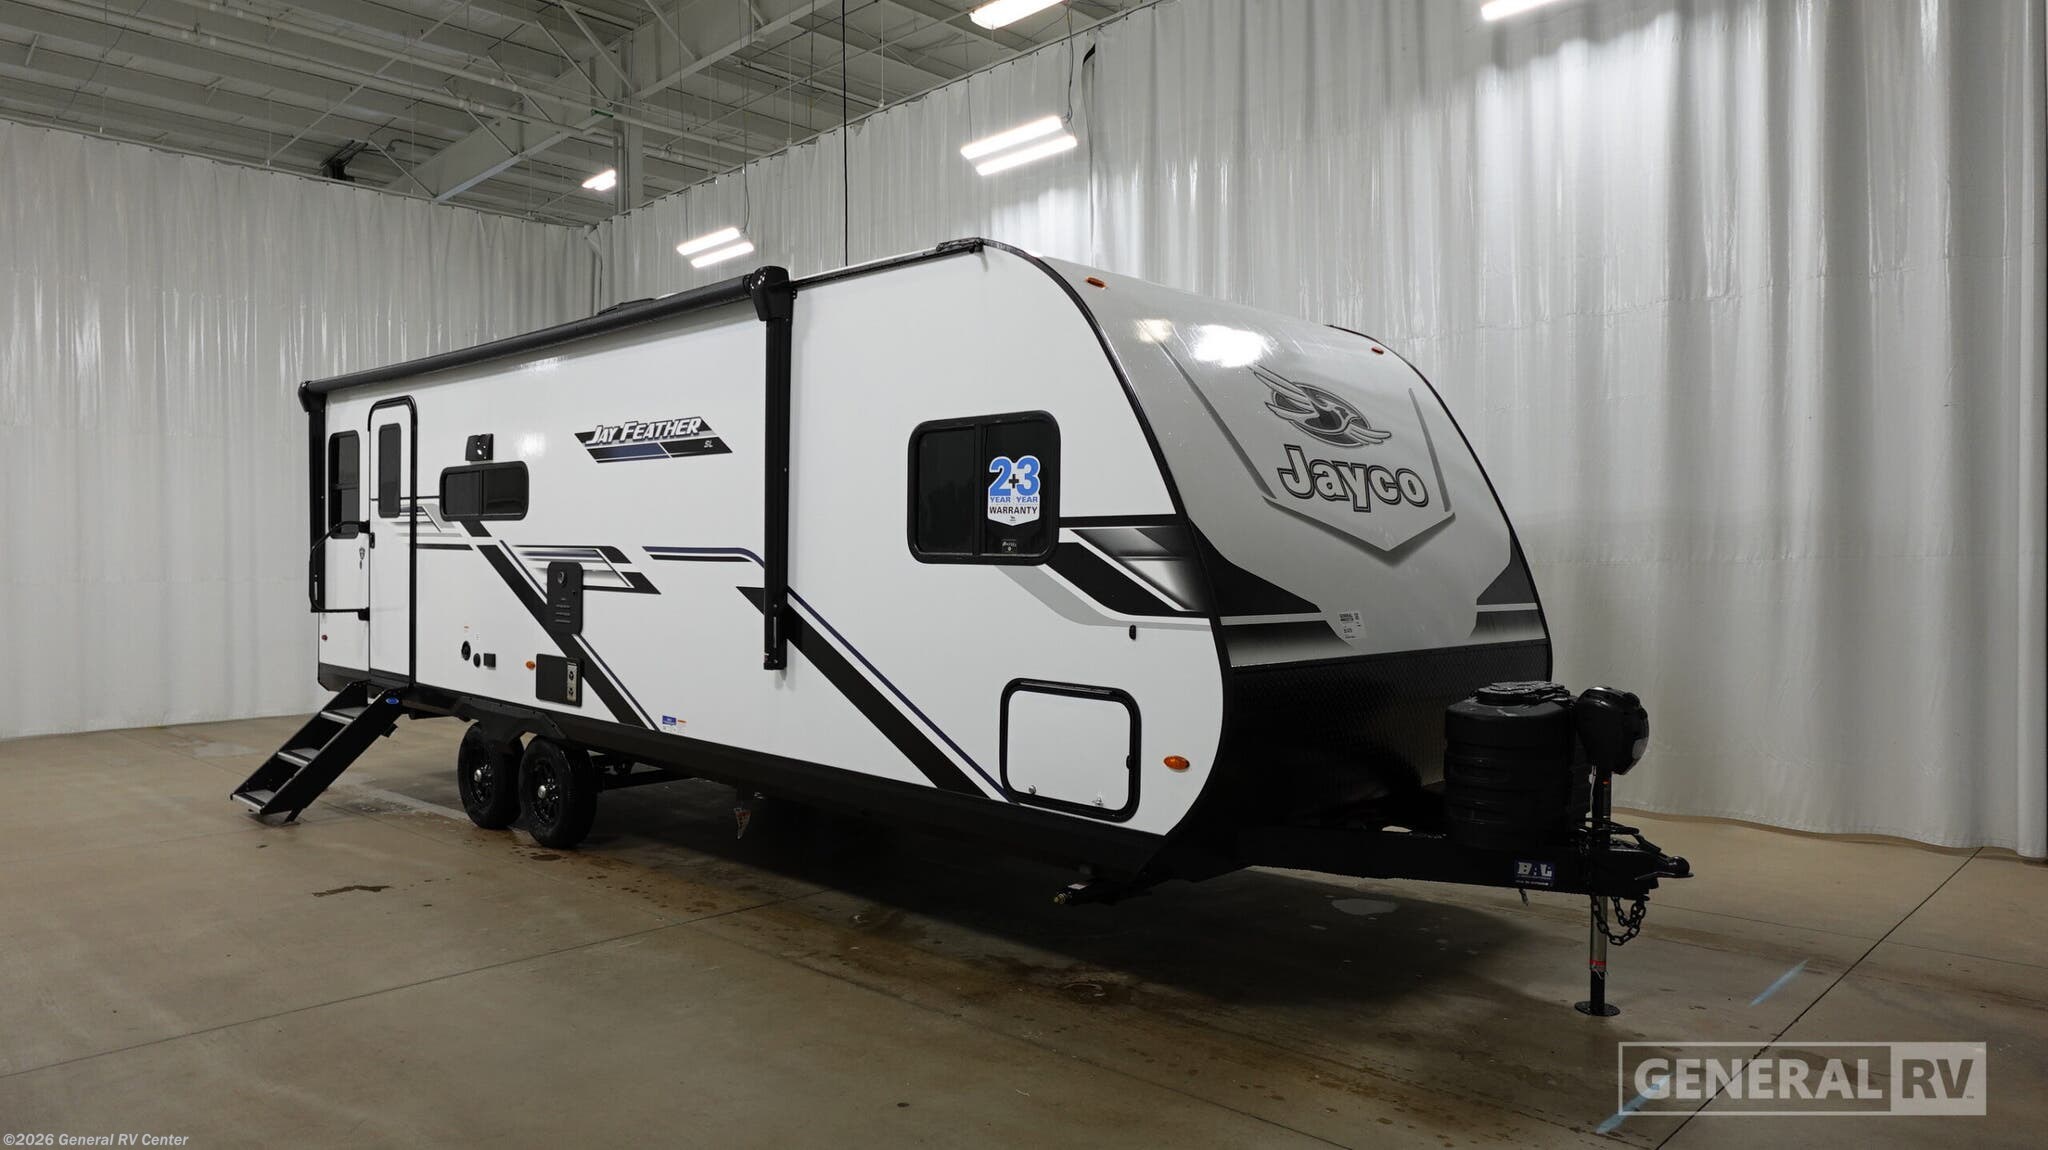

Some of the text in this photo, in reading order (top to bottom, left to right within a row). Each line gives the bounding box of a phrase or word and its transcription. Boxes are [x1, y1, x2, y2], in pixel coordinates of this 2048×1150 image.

[585, 417, 701, 446] JAY FEATHER
[1276, 444, 1428, 513] Jayco
[989, 506, 1038, 514] WARRANTY
